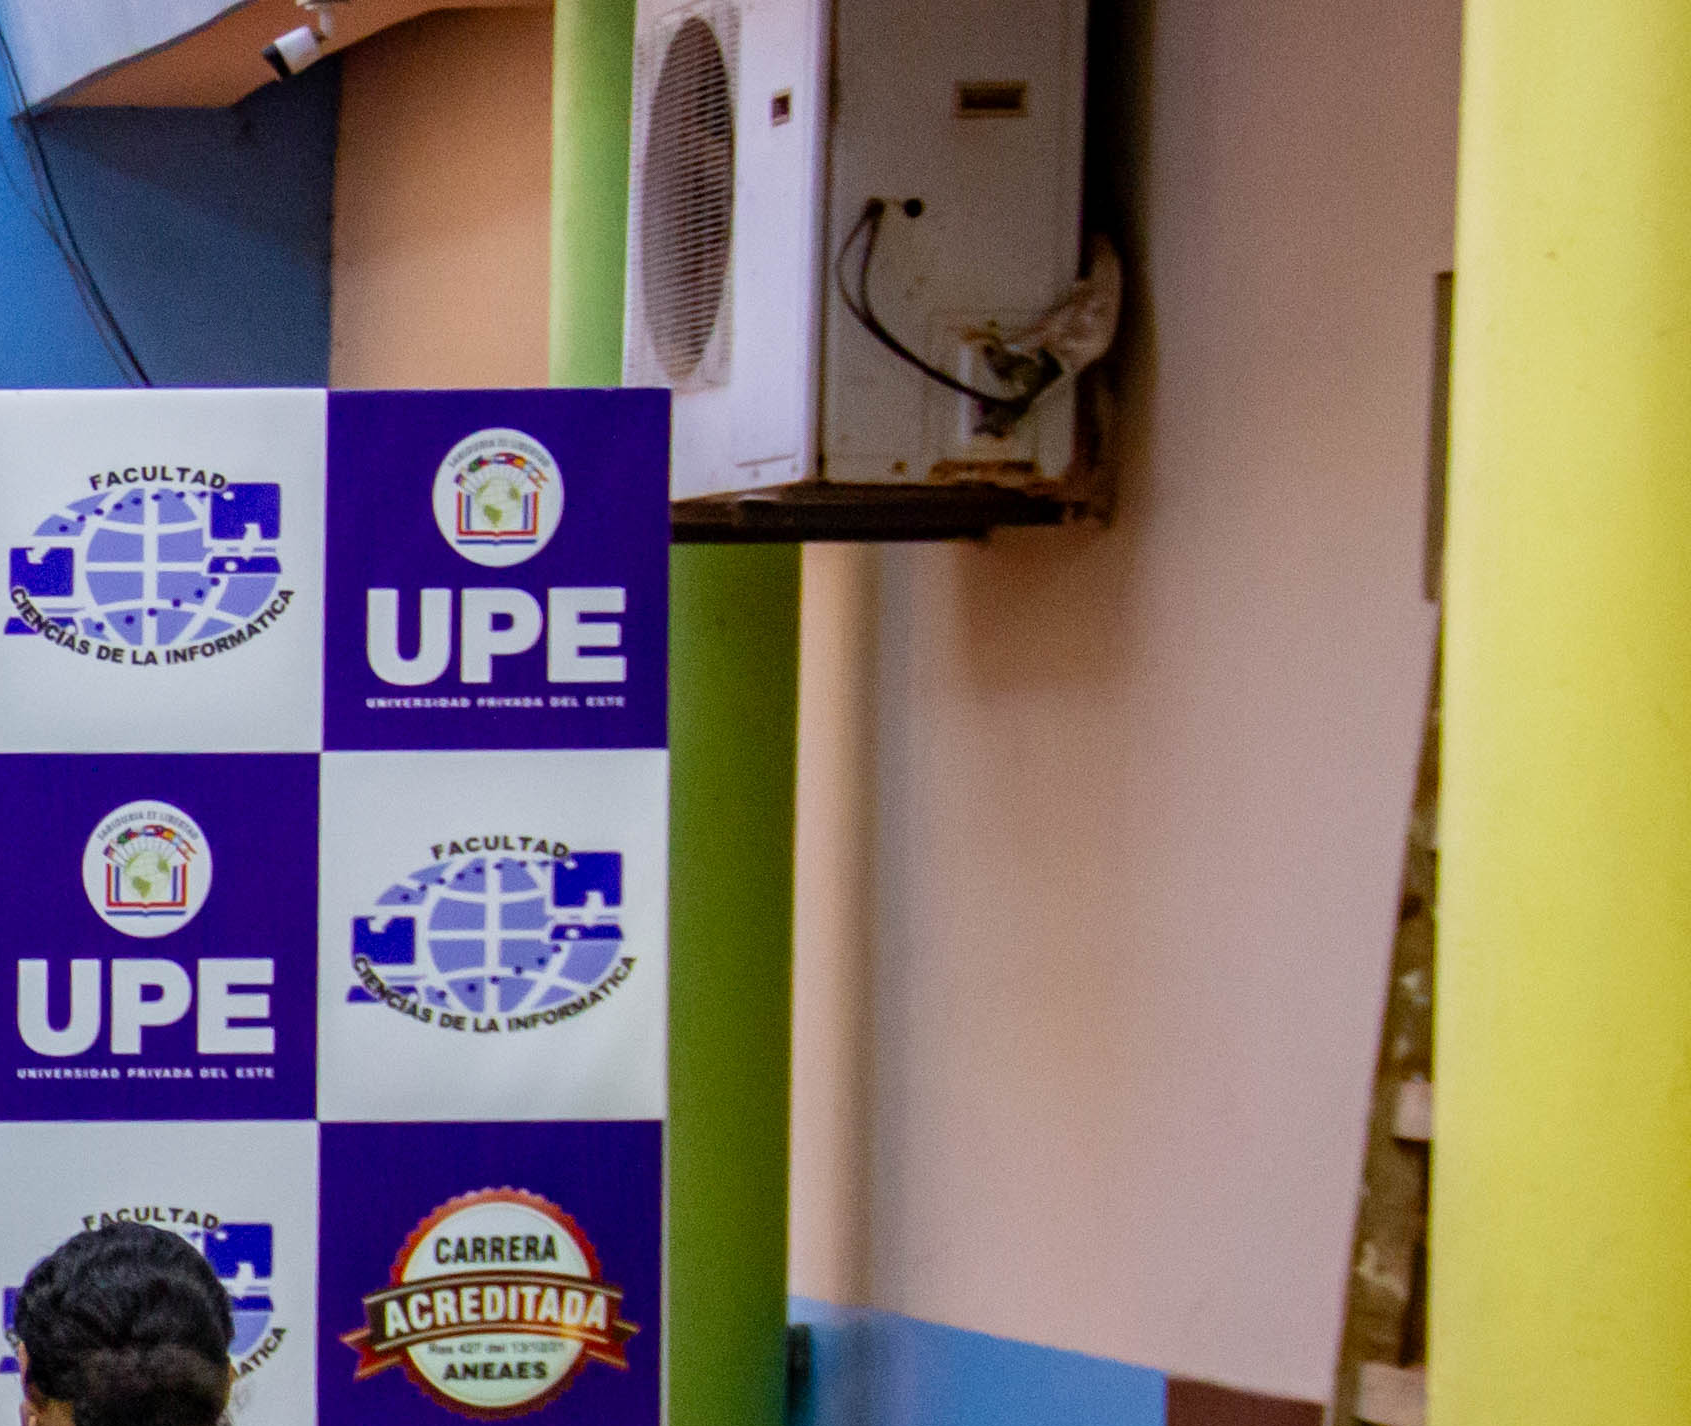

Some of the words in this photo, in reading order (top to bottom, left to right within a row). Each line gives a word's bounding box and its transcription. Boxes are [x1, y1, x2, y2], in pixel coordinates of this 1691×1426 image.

[89, 466, 226, 491] FACULTAD
[10, 588, 90, 655] CIENCIAS
[96, 645, 124, 663] DE
[132, 650, 158, 665] LA
[166, 588, 295, 664] INFORMATICA
[366, 586, 627, 686] UPE
[431, 835, 569, 861] FACULTAD
[17, 957, 275, 1057] UPE
[353, 956, 432, 1023] CIENCIAS
[439, 1013, 466, 1031] DE
[473, 1017, 500, 1033] LA
[507, 956, 636, 1031] INFORMATICA
[17, 1067, 120, 1079] UNIVERSIDAD
[200, 1067, 228, 1078] DEL
[82, 1207, 219, 1232] FACULTAD
[435, 1234, 558, 1264] CARRERA
[384, 1285, 607, 1338] ACREDITADA
[443, 1361, 547, 1380] ANEAES
